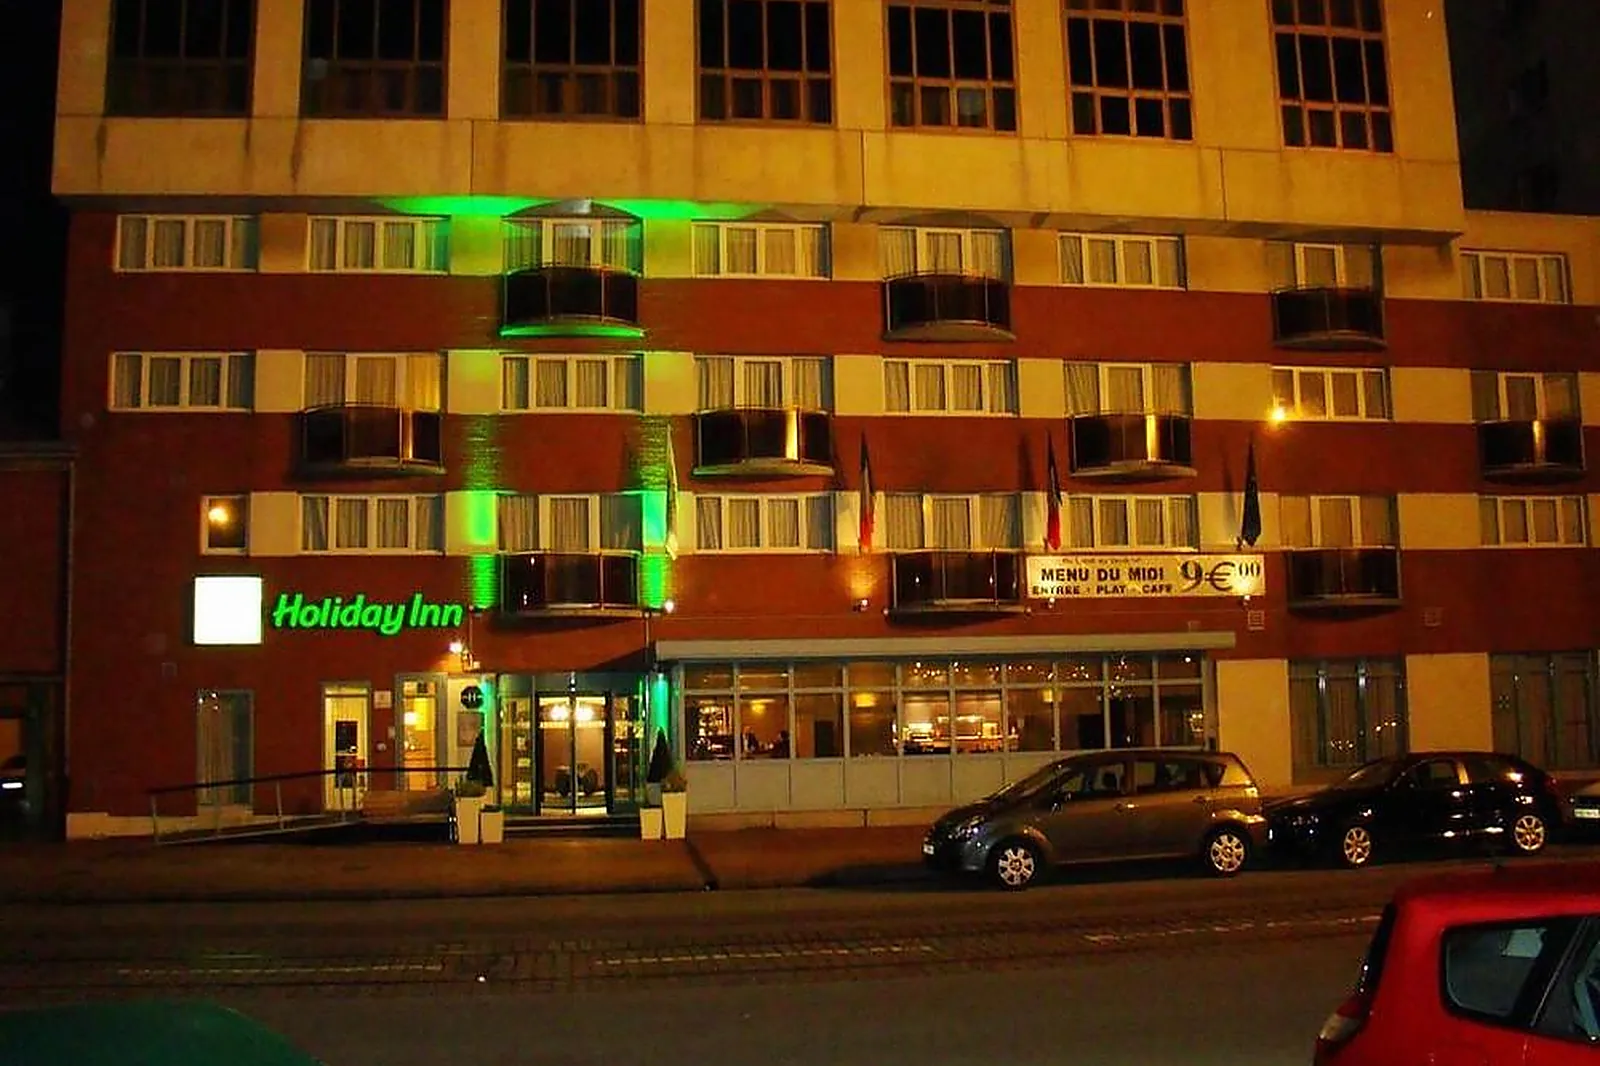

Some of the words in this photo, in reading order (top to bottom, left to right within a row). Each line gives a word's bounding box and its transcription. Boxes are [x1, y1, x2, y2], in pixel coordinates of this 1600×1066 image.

[1041, 568, 1089, 581] MENU
[1097, 567, 1120, 581] DU
[1129, 566, 1164, 581] MIDI
[273, 593, 406, 635] Holiday
[409, 592, 463, 628] Inn
